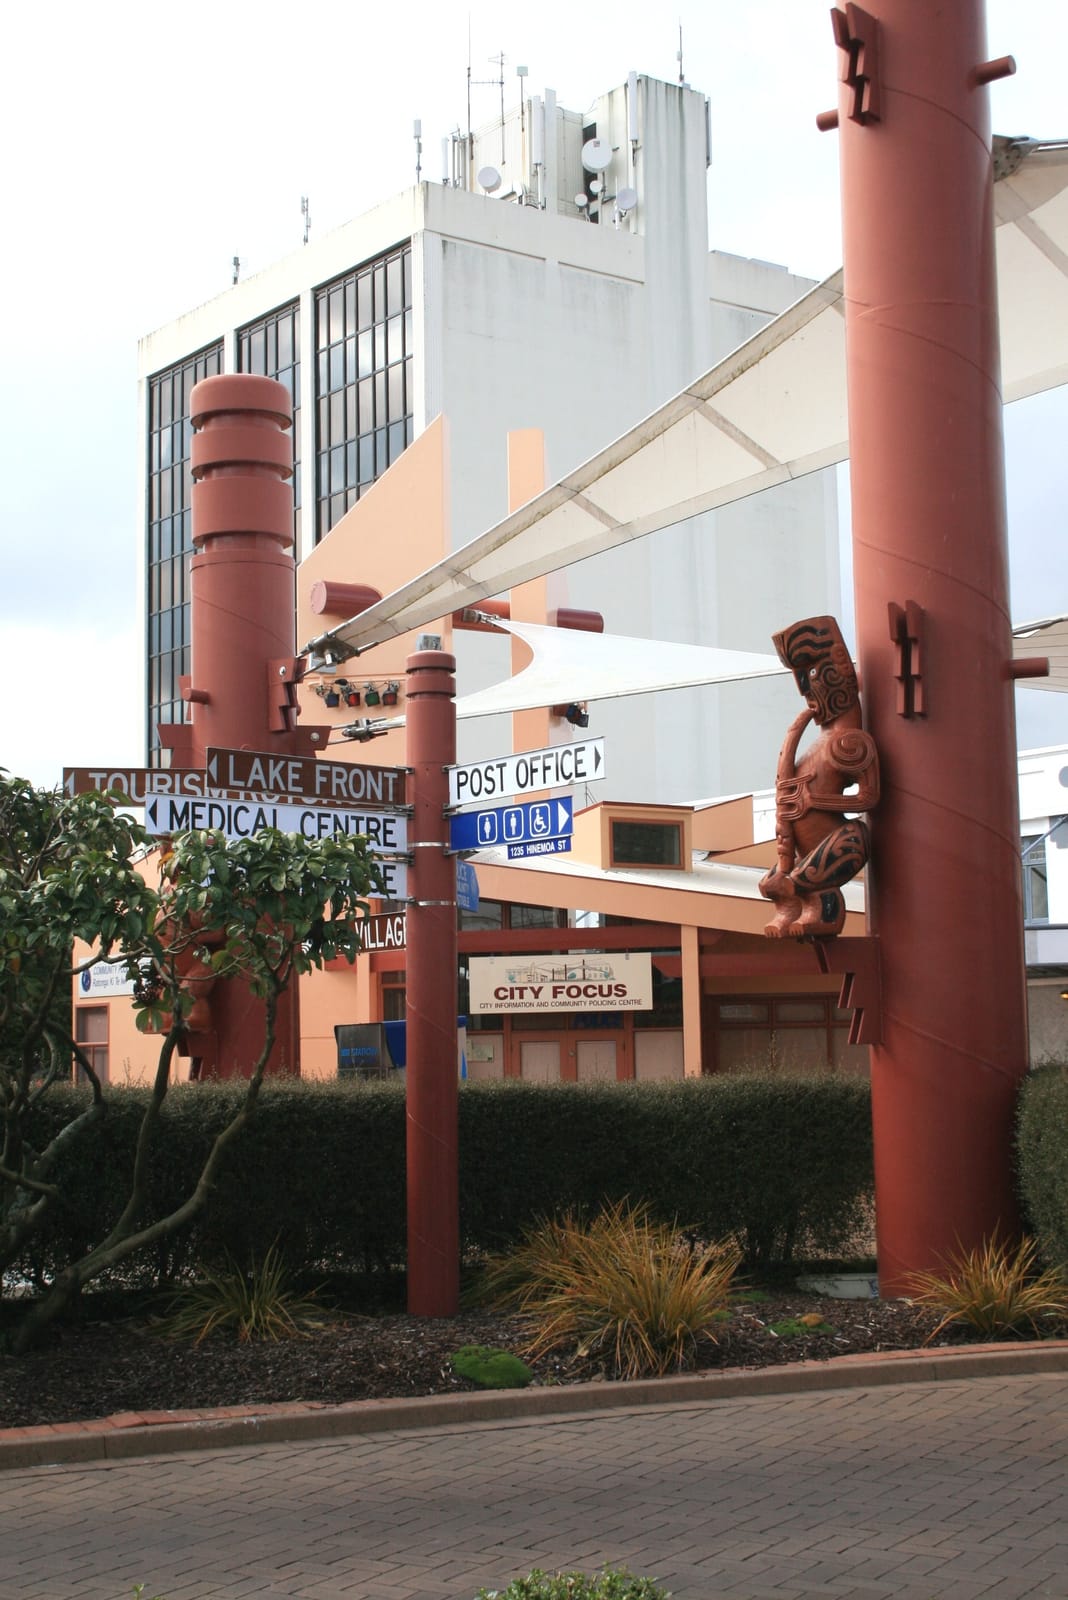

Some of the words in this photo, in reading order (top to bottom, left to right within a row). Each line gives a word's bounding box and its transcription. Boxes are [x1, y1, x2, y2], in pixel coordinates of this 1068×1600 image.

[228, 754, 304, 793] LAKE
[315, 764, 398, 802] FRONT
[456, 762, 507, 800] POST
[516, 746, 587, 789] OFFICE
[299, 810, 397, 848] CENTRE
[510, 845, 524, 857] 1235
[526, 841, 555, 855] HINEMOA
[557, 839, 567, 851] ST
[493, 985, 544, 1000] CITY
[552, 983, 628, 999] FOCUS
[550, 1000, 587, 1008] COMMUNITY
[588, 999, 617, 1007] POLICING
[618, 998, 643, 1006] CENTRE
